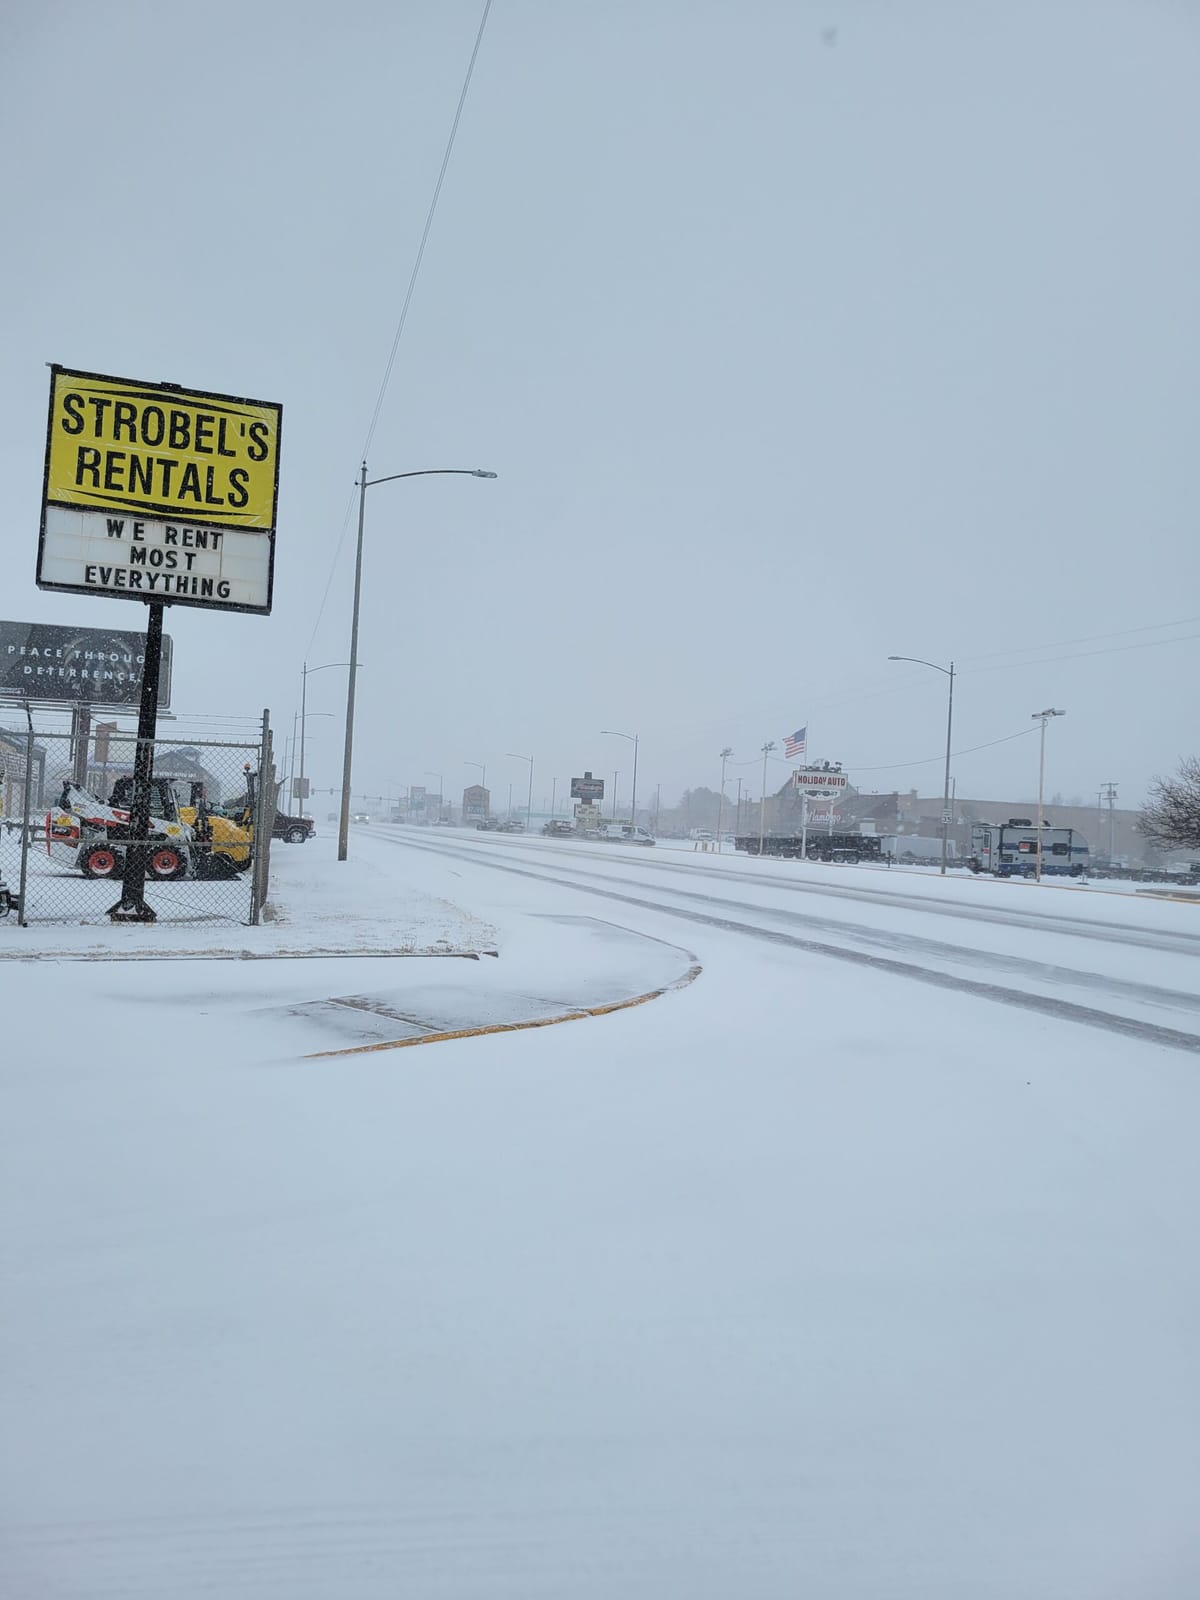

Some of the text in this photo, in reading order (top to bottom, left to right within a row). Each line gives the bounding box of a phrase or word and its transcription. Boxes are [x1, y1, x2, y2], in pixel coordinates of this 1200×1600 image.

[61, 393, 269, 461] STROBEL'S
[75, 446, 249, 508] RENTALS
[106, 518, 223, 550] WE RENT
[129, 546, 196, 570] MOST
[84, 564, 231, 598] EVERYTHING
[8, 645, 62, 657] PEACE
[798, 775, 846, 786] HOLIDAY AUTO
